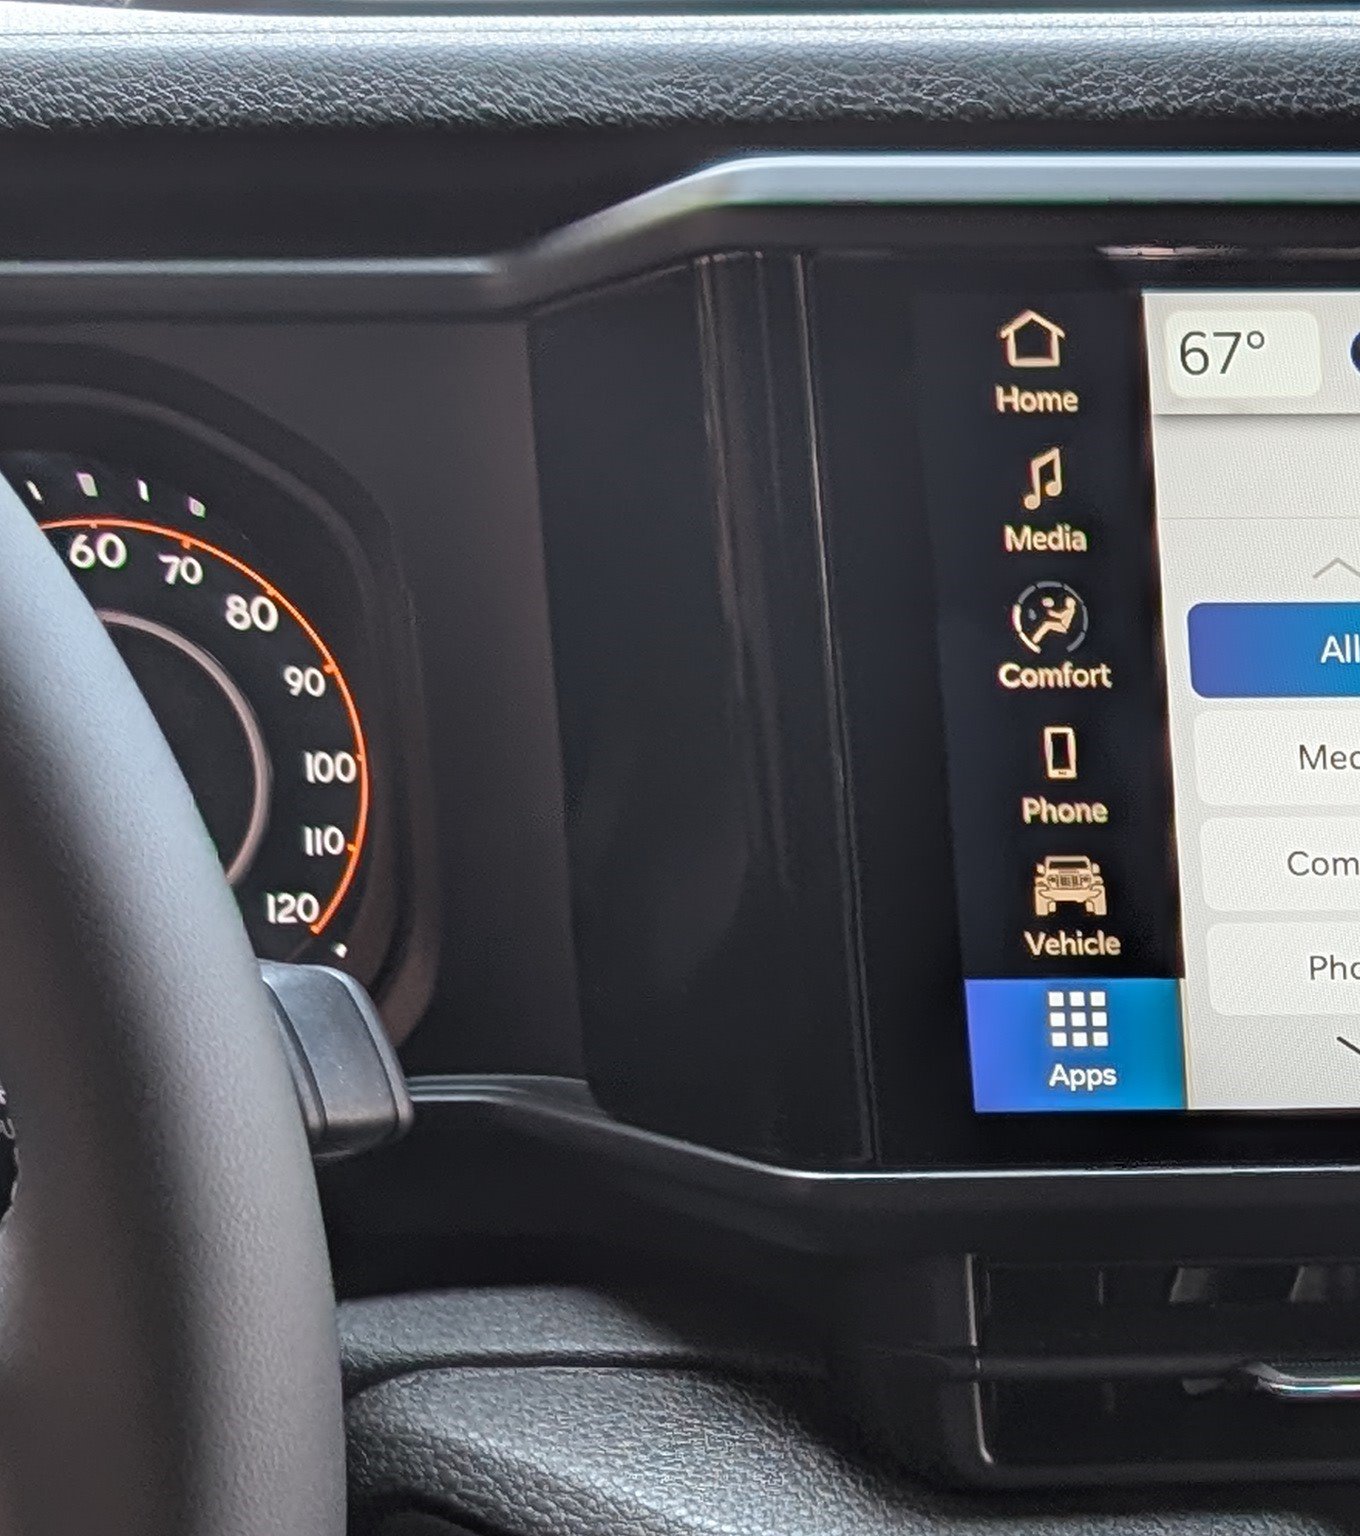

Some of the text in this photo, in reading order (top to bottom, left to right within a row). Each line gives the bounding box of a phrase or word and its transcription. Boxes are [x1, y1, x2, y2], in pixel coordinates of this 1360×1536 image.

[1179, 329, 1265, 376] 67°
[995, 386, 1078, 413] Home
[69, 532, 127, 568] 60
[1004, 525, 1088, 552] Media
[158, 554, 203, 585] 70
[225, 594, 279, 633] 80
[284, 666, 325, 697] 90
[998, 662, 1112, 689] Comfort
[304, 750, 357, 784] 100
[1021, 798, 1108, 824] Phone
[303, 825, 345, 857] 110
[266, 892, 320, 924] 120
[1024, 931, 1121, 957] Vehicle
[1049, 1064, 1117, 1092] Apps
